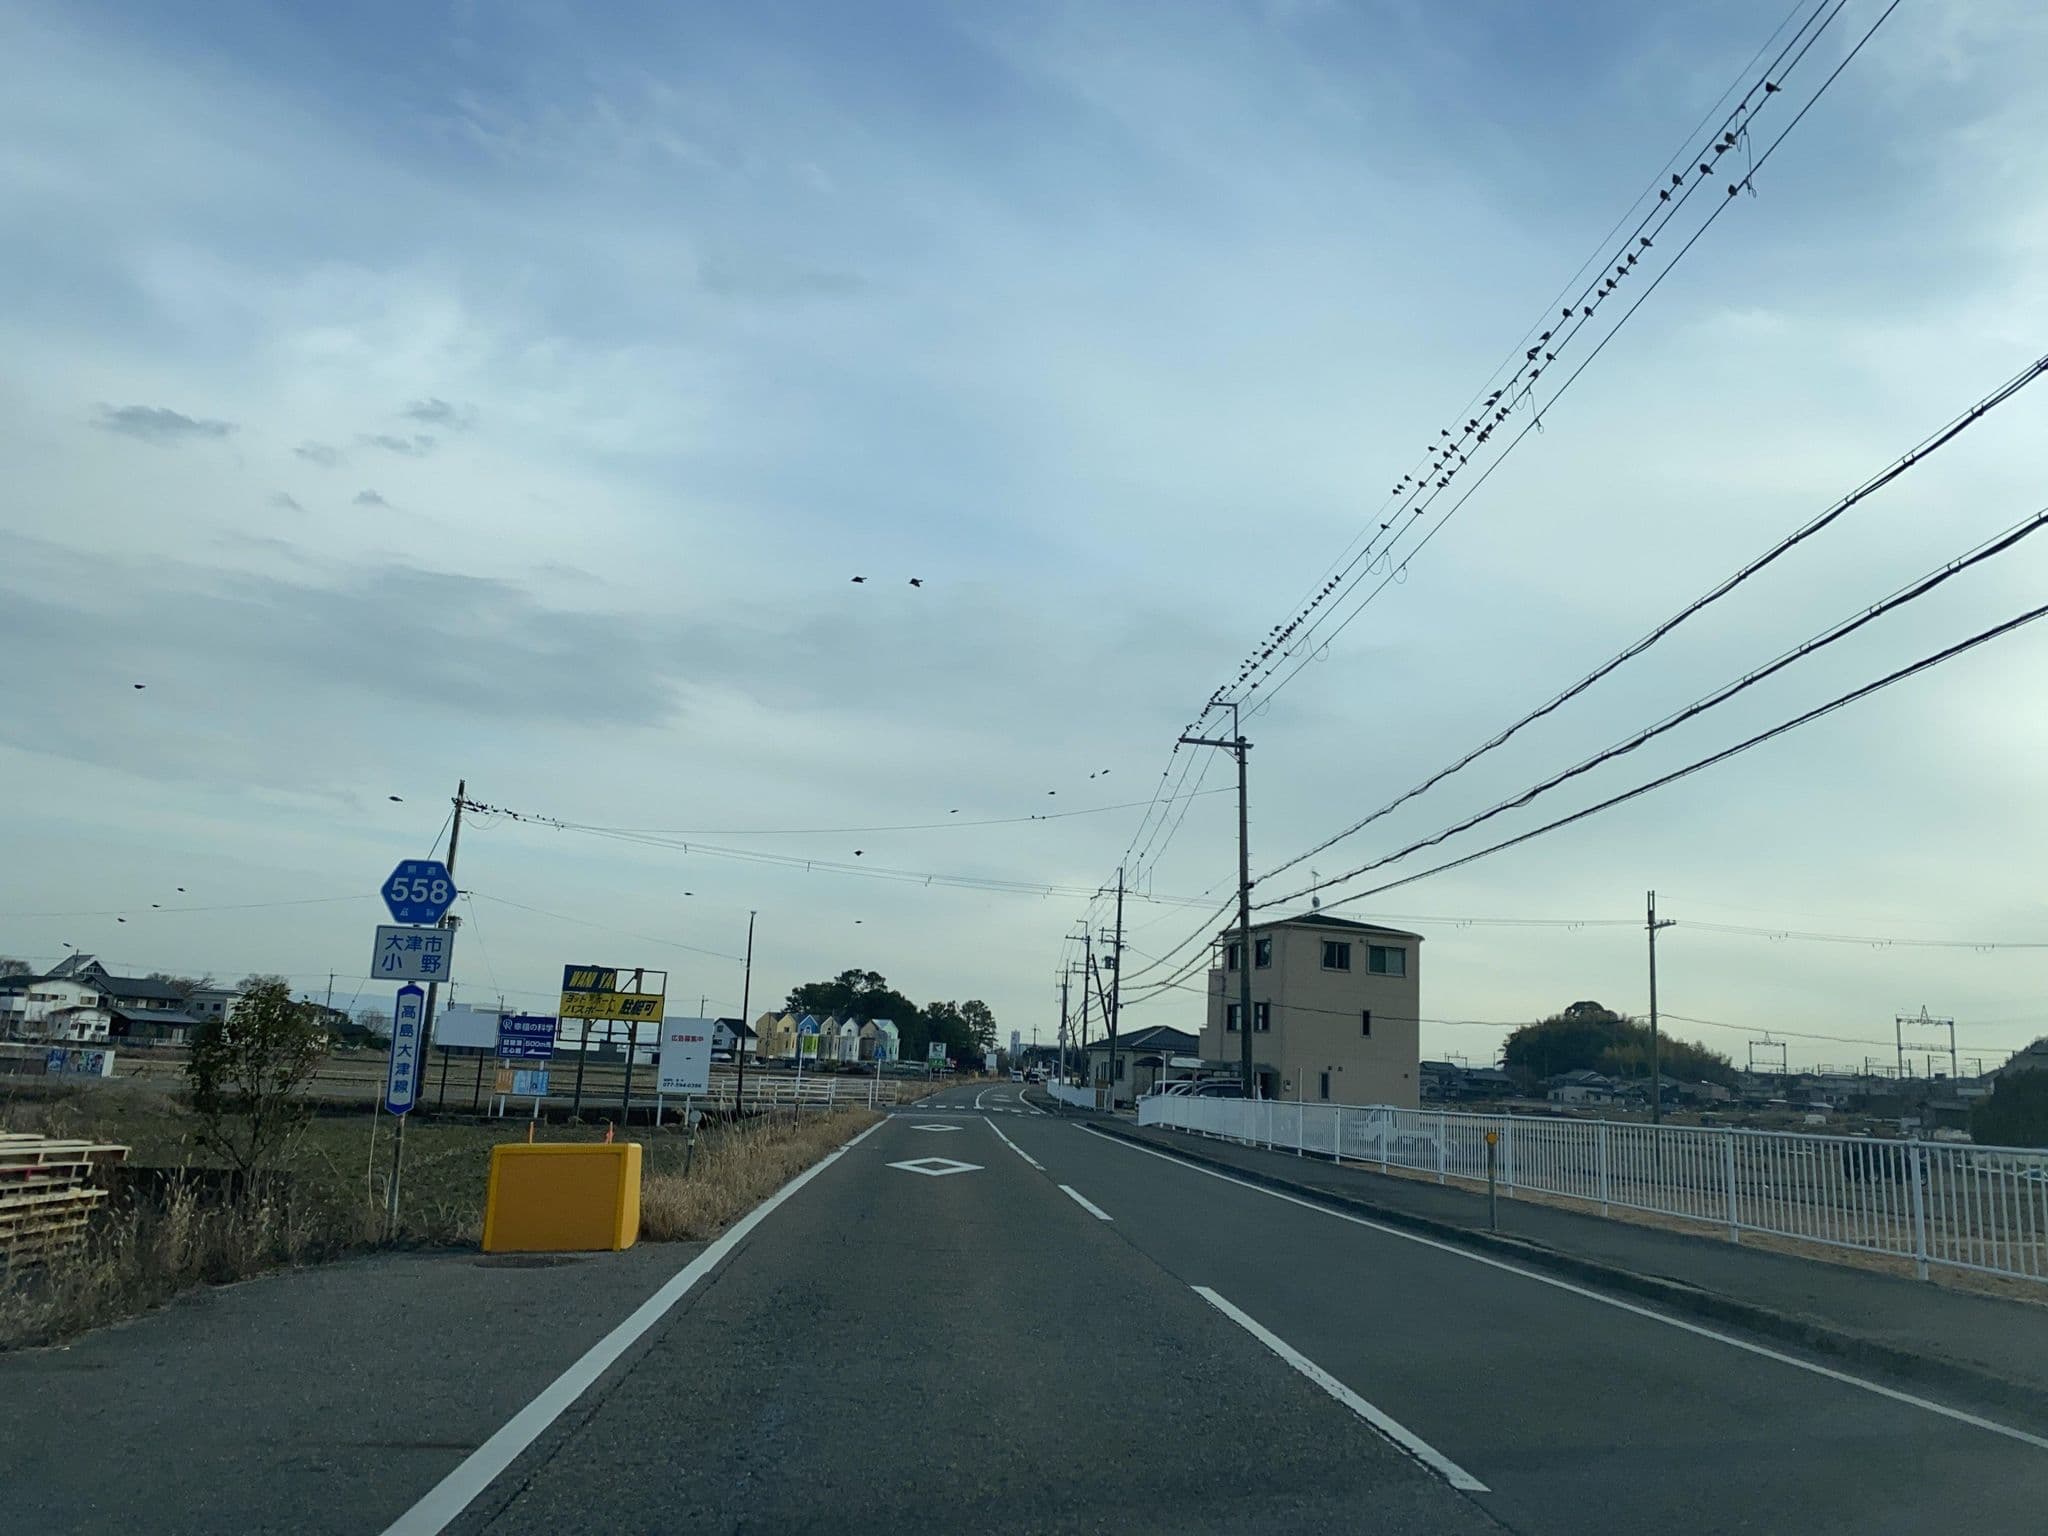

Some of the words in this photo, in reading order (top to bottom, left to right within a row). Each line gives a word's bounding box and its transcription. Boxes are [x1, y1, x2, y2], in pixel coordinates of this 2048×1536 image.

[391, 878, 448, 905] 558
[385, 935, 443, 953] 大津市
[382, 953, 442, 974] 小野
[392, 1005, 417, 1094] 高島大津線
